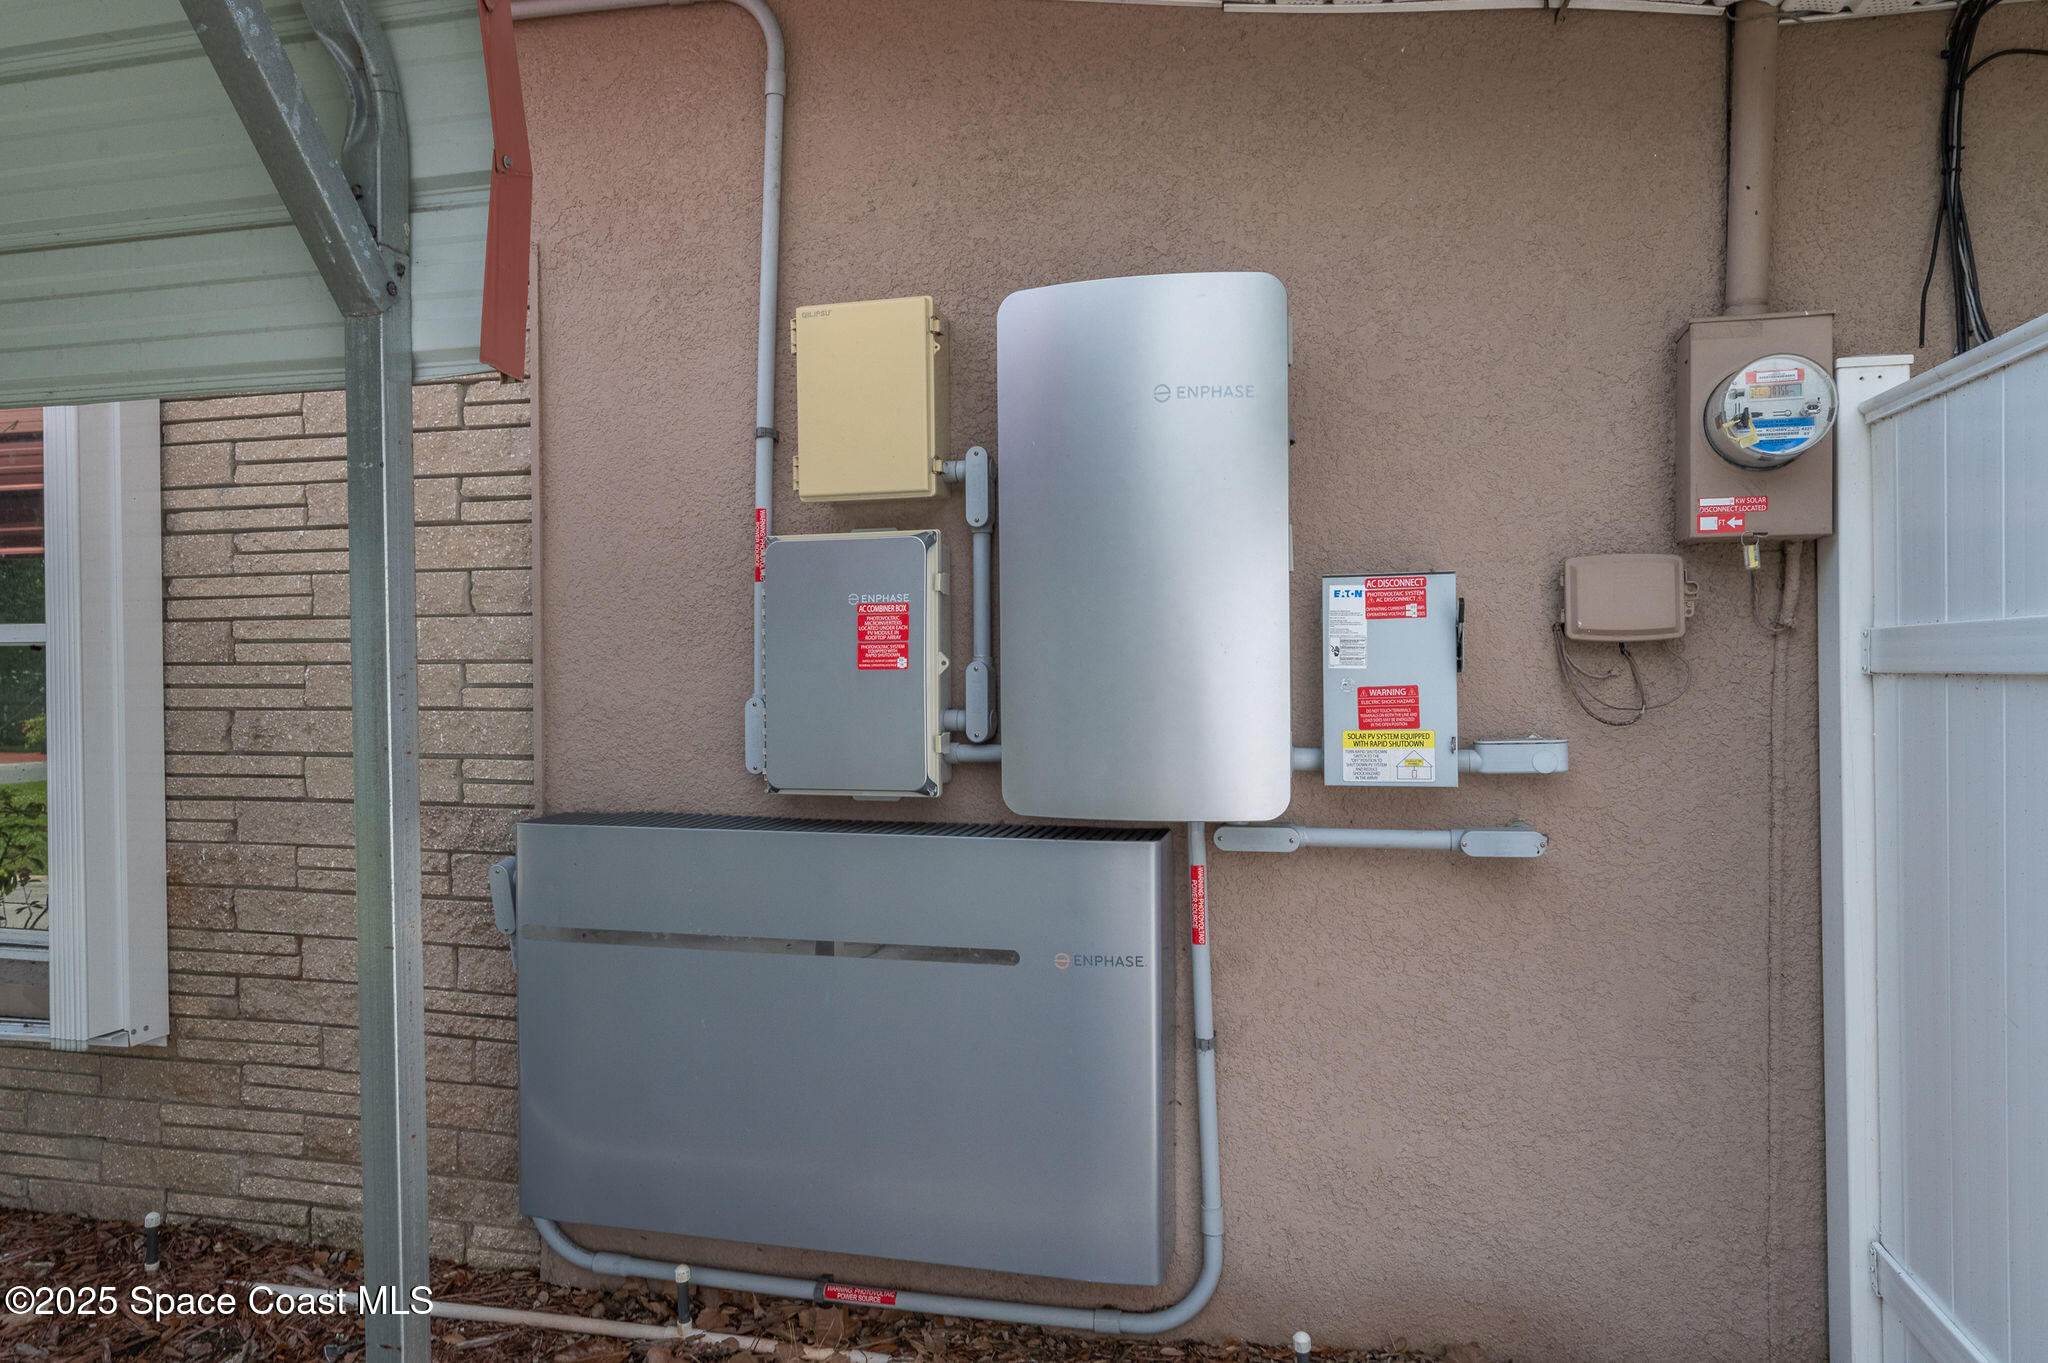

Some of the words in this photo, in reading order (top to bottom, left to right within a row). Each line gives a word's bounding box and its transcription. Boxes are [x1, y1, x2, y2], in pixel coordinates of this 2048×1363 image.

[801, 310, 831, 318] QILIPSU
[1176, 385, 1255, 398] ENPHASE
[1378, 578, 1424, 588] DISCONNECT
[862, 594, 910, 603] ENPHASE
[1074, 955, 1144, 967] ENPHASE
[837, 1293, 857, 1301] POWER
[858, 1295, 881, 1303] SOURCE
[854, 1288, 895, 1298] PHOTOVOLTAIC
